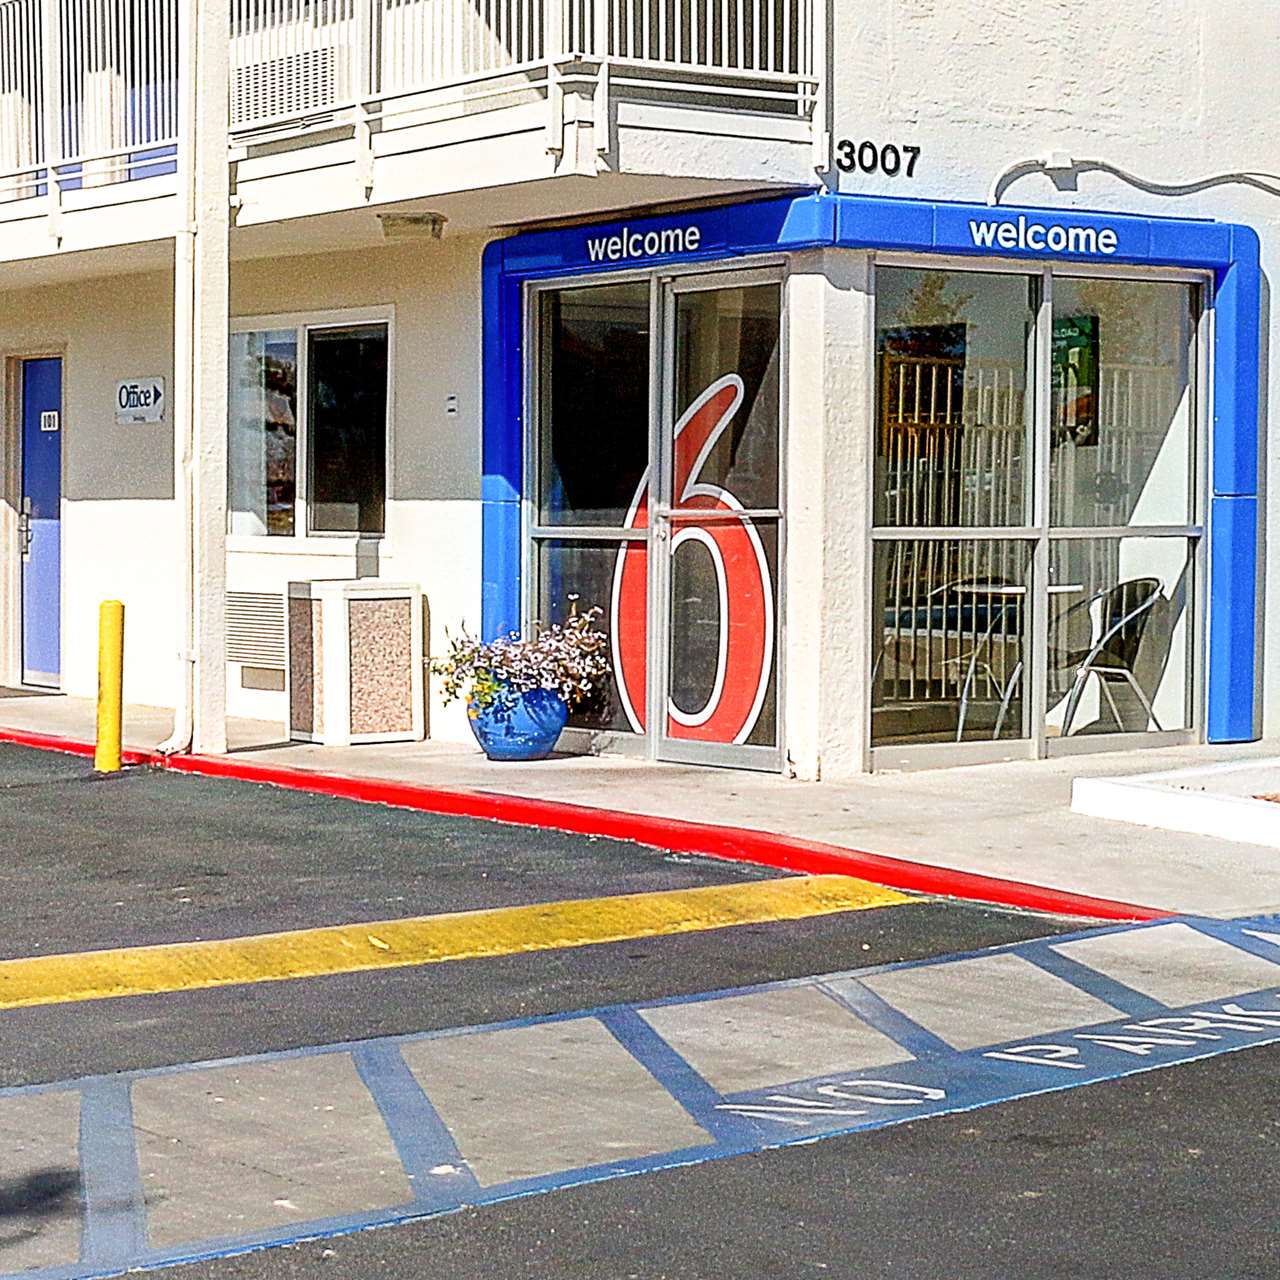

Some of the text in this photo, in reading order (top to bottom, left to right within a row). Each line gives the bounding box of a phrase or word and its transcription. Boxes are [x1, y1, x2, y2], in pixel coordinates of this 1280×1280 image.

[836, 139, 921, 178] 3007
[587, 223, 701, 262] welcome
[969, 215, 1118, 255] welcome
[119, 384, 151, 409] Office
[43, 414, 56, 429] 101
[610, 373, 773, 745] 6
[716, 1079, 947, 1126] NO
